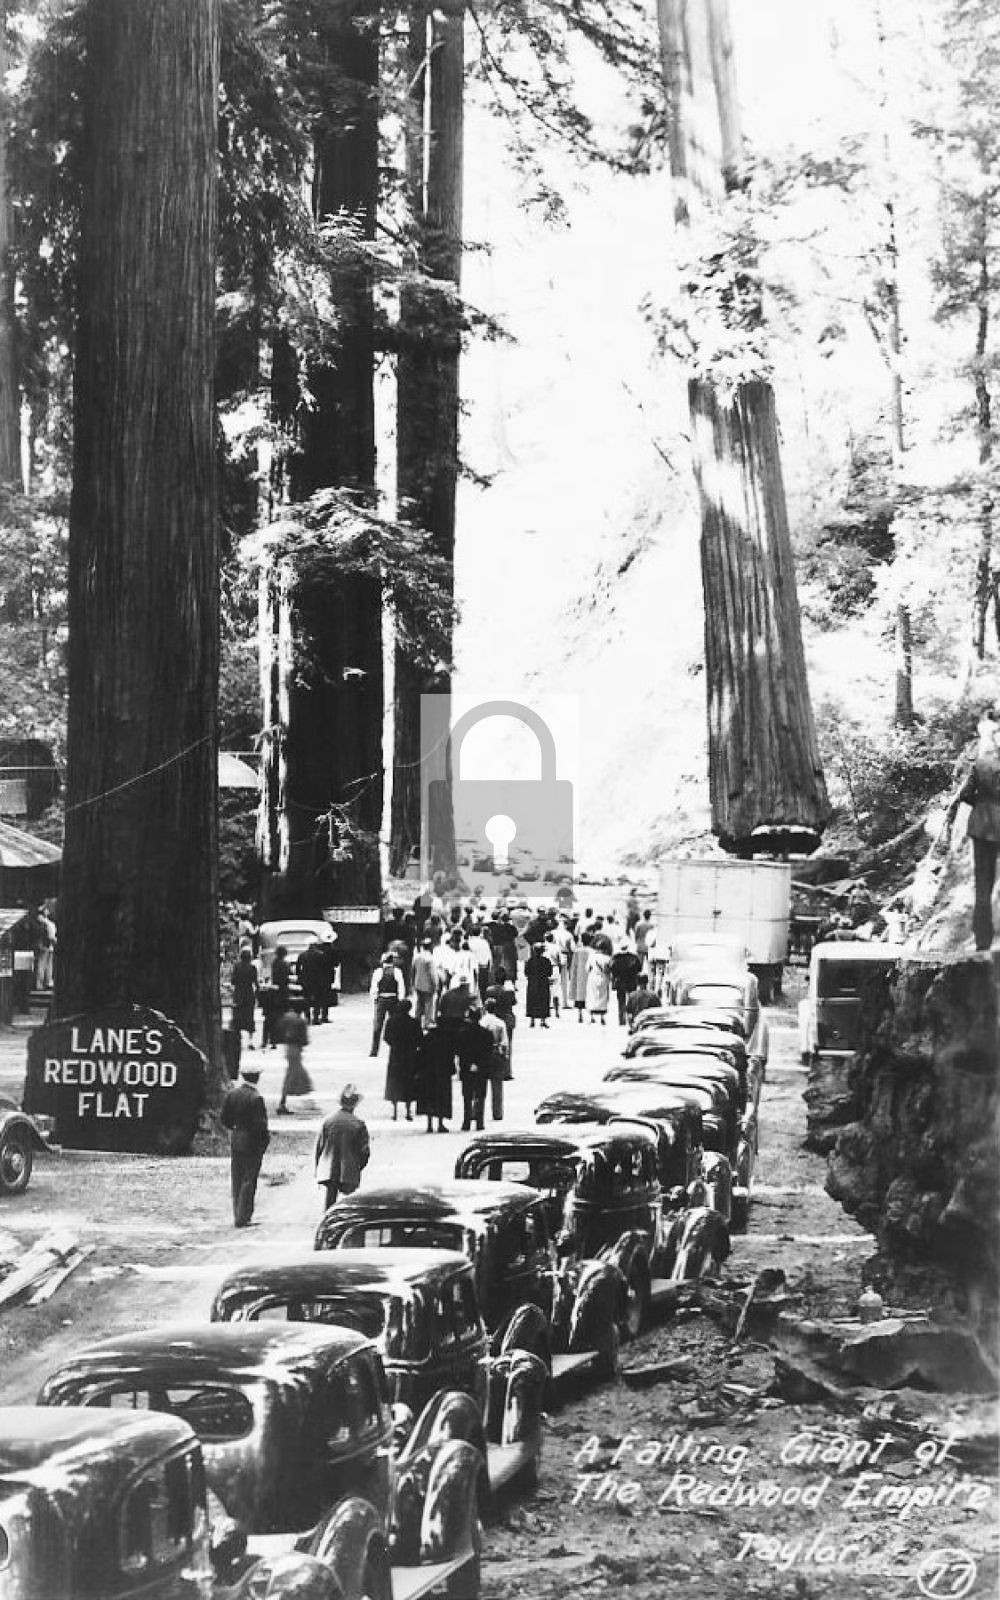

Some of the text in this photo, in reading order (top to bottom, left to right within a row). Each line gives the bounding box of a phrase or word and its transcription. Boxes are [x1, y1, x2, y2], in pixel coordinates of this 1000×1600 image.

[71, 1025, 163, 1054] LANE'S
[44, 1058, 177, 1087] REDWOOD
[78, 1092, 150, 1118] FLAT
